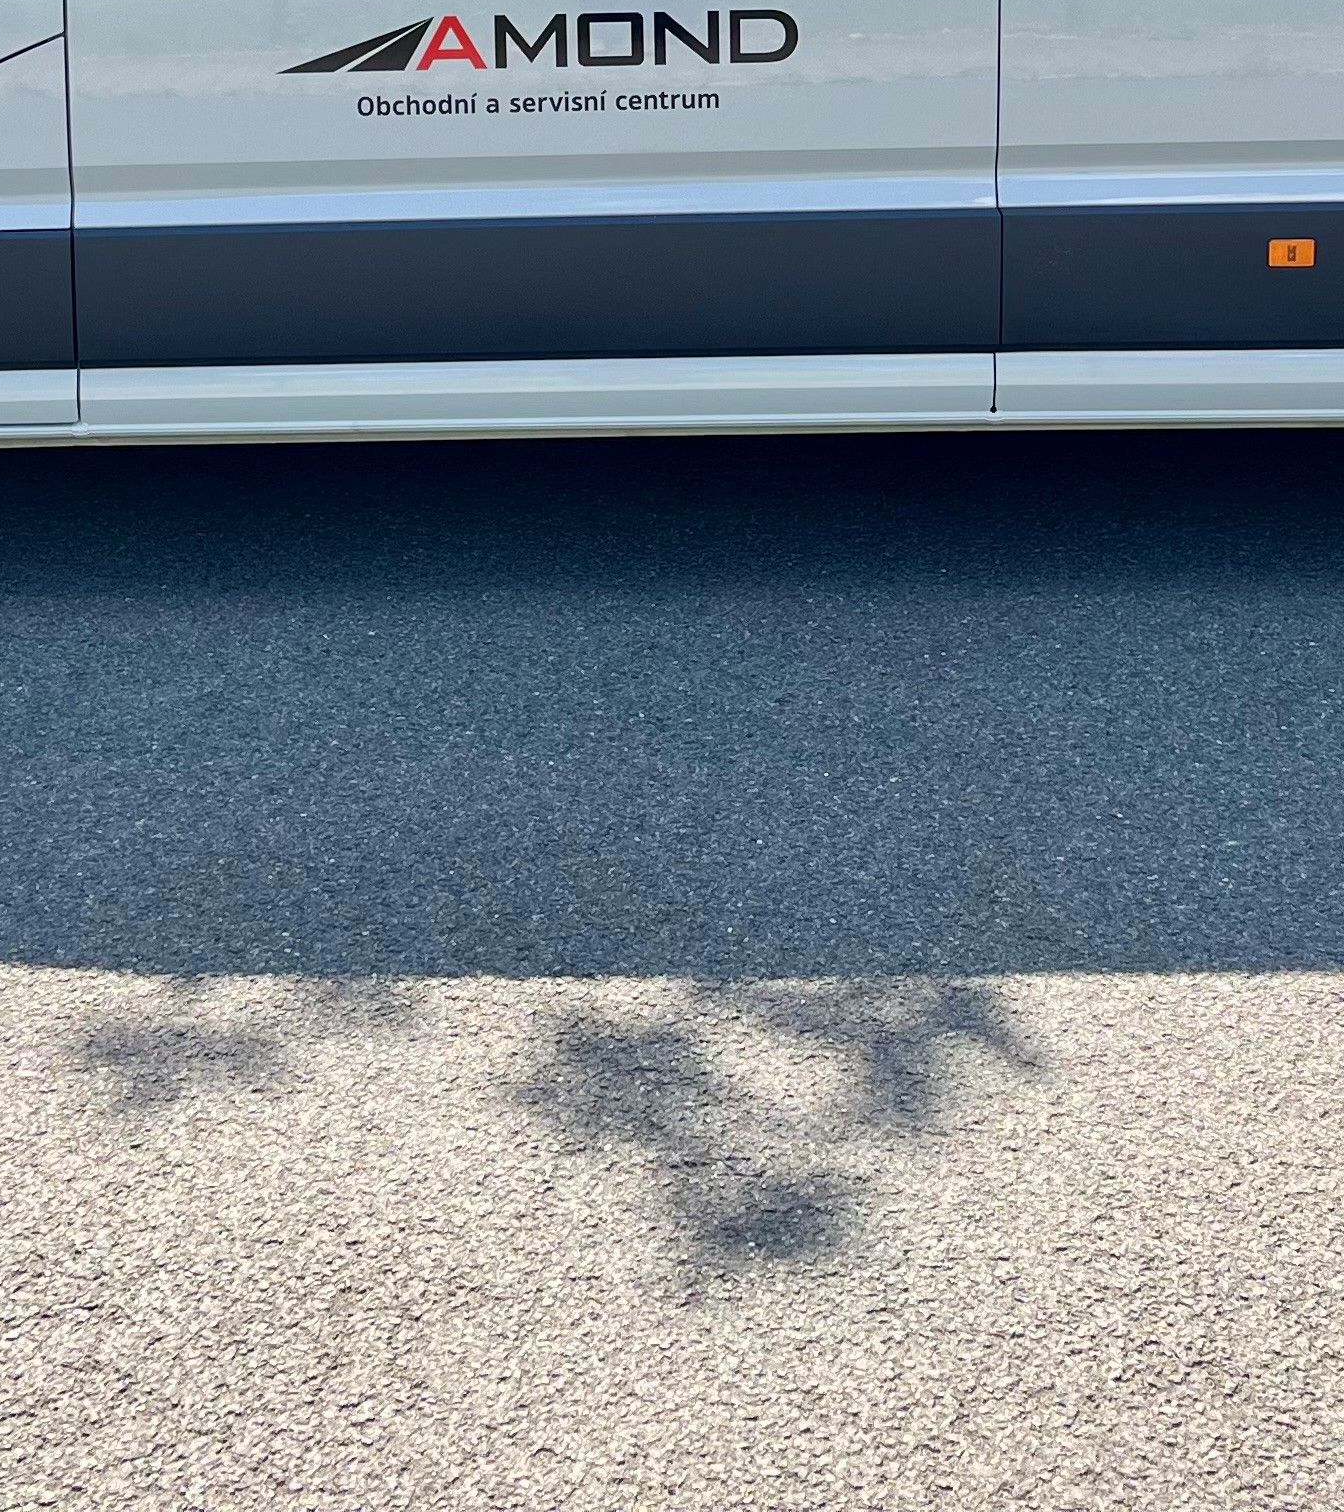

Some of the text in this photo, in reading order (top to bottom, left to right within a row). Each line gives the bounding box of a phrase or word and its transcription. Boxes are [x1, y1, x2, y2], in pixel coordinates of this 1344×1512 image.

[415, 8, 799, 72] AMOND
[356, 90, 720, 117] Obchodní a servisní centrum
